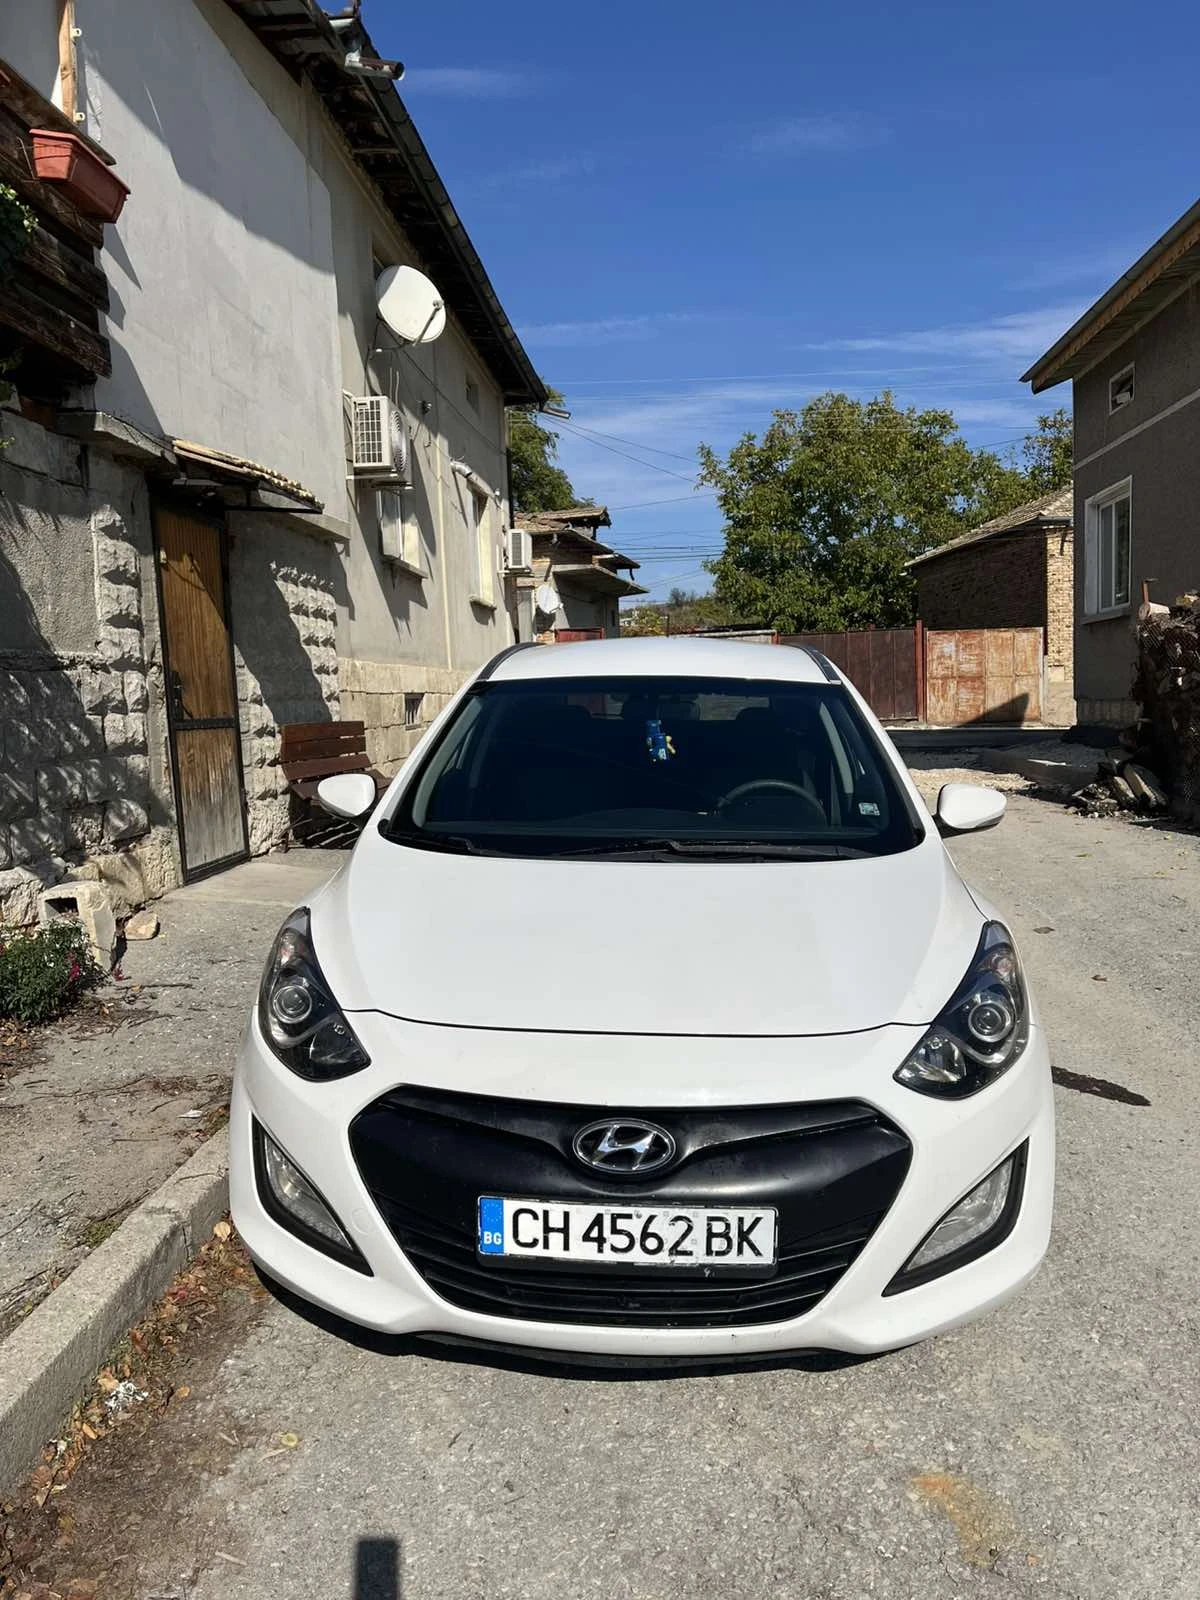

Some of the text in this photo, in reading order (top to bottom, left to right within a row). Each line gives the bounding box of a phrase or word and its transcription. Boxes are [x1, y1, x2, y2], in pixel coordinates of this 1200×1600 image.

[483, 1232, 502, 1244] BG
[512, 1208, 764, 1257] CH 4562 BK
